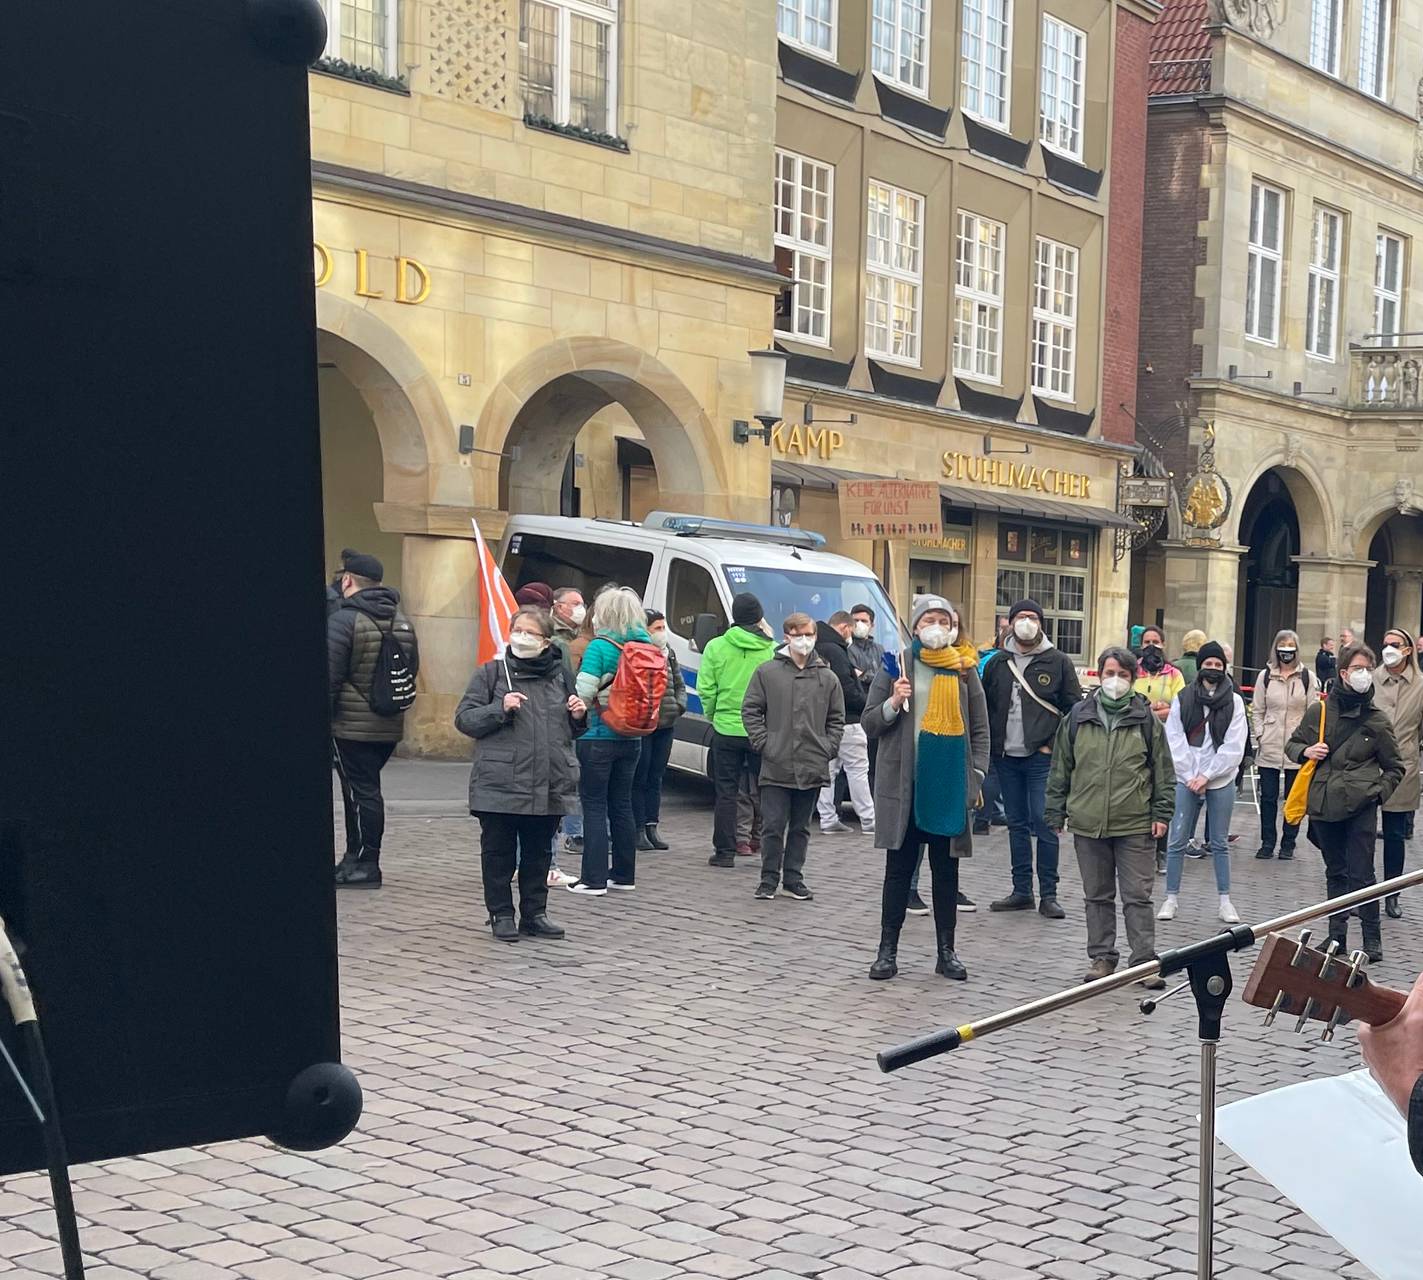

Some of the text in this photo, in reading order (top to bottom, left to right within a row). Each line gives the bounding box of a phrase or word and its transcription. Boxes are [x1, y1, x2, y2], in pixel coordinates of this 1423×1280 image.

[772, 421, 844, 460] KAMP
[879, 482, 933, 499] ALTERNATIVE
[942, 451, 1091, 499] STUHLMACHER
